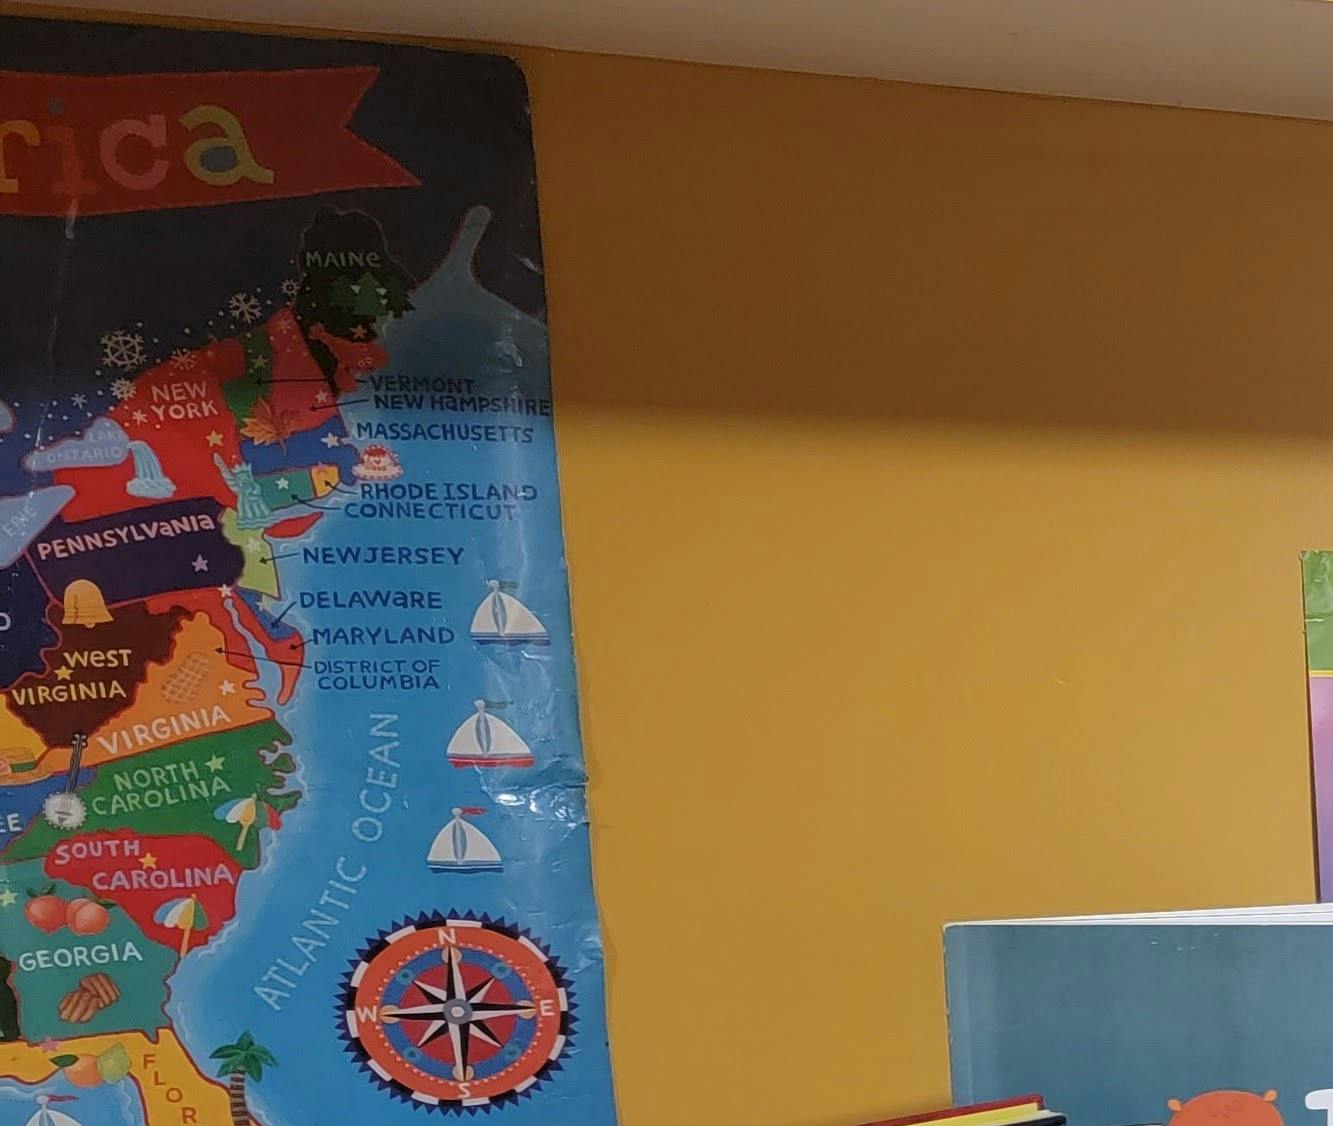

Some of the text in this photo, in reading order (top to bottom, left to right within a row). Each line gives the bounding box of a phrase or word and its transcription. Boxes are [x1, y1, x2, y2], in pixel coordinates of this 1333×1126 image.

[152, 381, 207, 400] NEW
[370, 375, 475, 394] VERMONT
[151, 400, 218, 421] YORK
[375, 395, 423, 410] NEW
[356, 422, 534, 444] MASSACHUSETTS
[361, 483, 538, 500] RHODE ISLAND
[344, 503, 516, 520] CONNECTICUT
[303, 547, 464, 565] NEW JERSEY
[313, 627, 454, 645] MARYLAND
[315, 660, 439, 674] DISTRICT OF
[318, 675, 439, 690] COLUMBIA
[11, 680, 127, 707] VIRGINIA
[96, 705, 232, 754] VIRGINIA
[113, 761, 200, 791] NORTH
[352, 711, 400, 843] OCEAN
[92, 777, 232, 816] CAROLINA
[54, 838, 140, 866] SOUTH
[91, 863, 234, 890] CAROLINA
[252, 856, 369, 1012] ATLANTIC
[18, 941, 144, 971] GEORGIA
